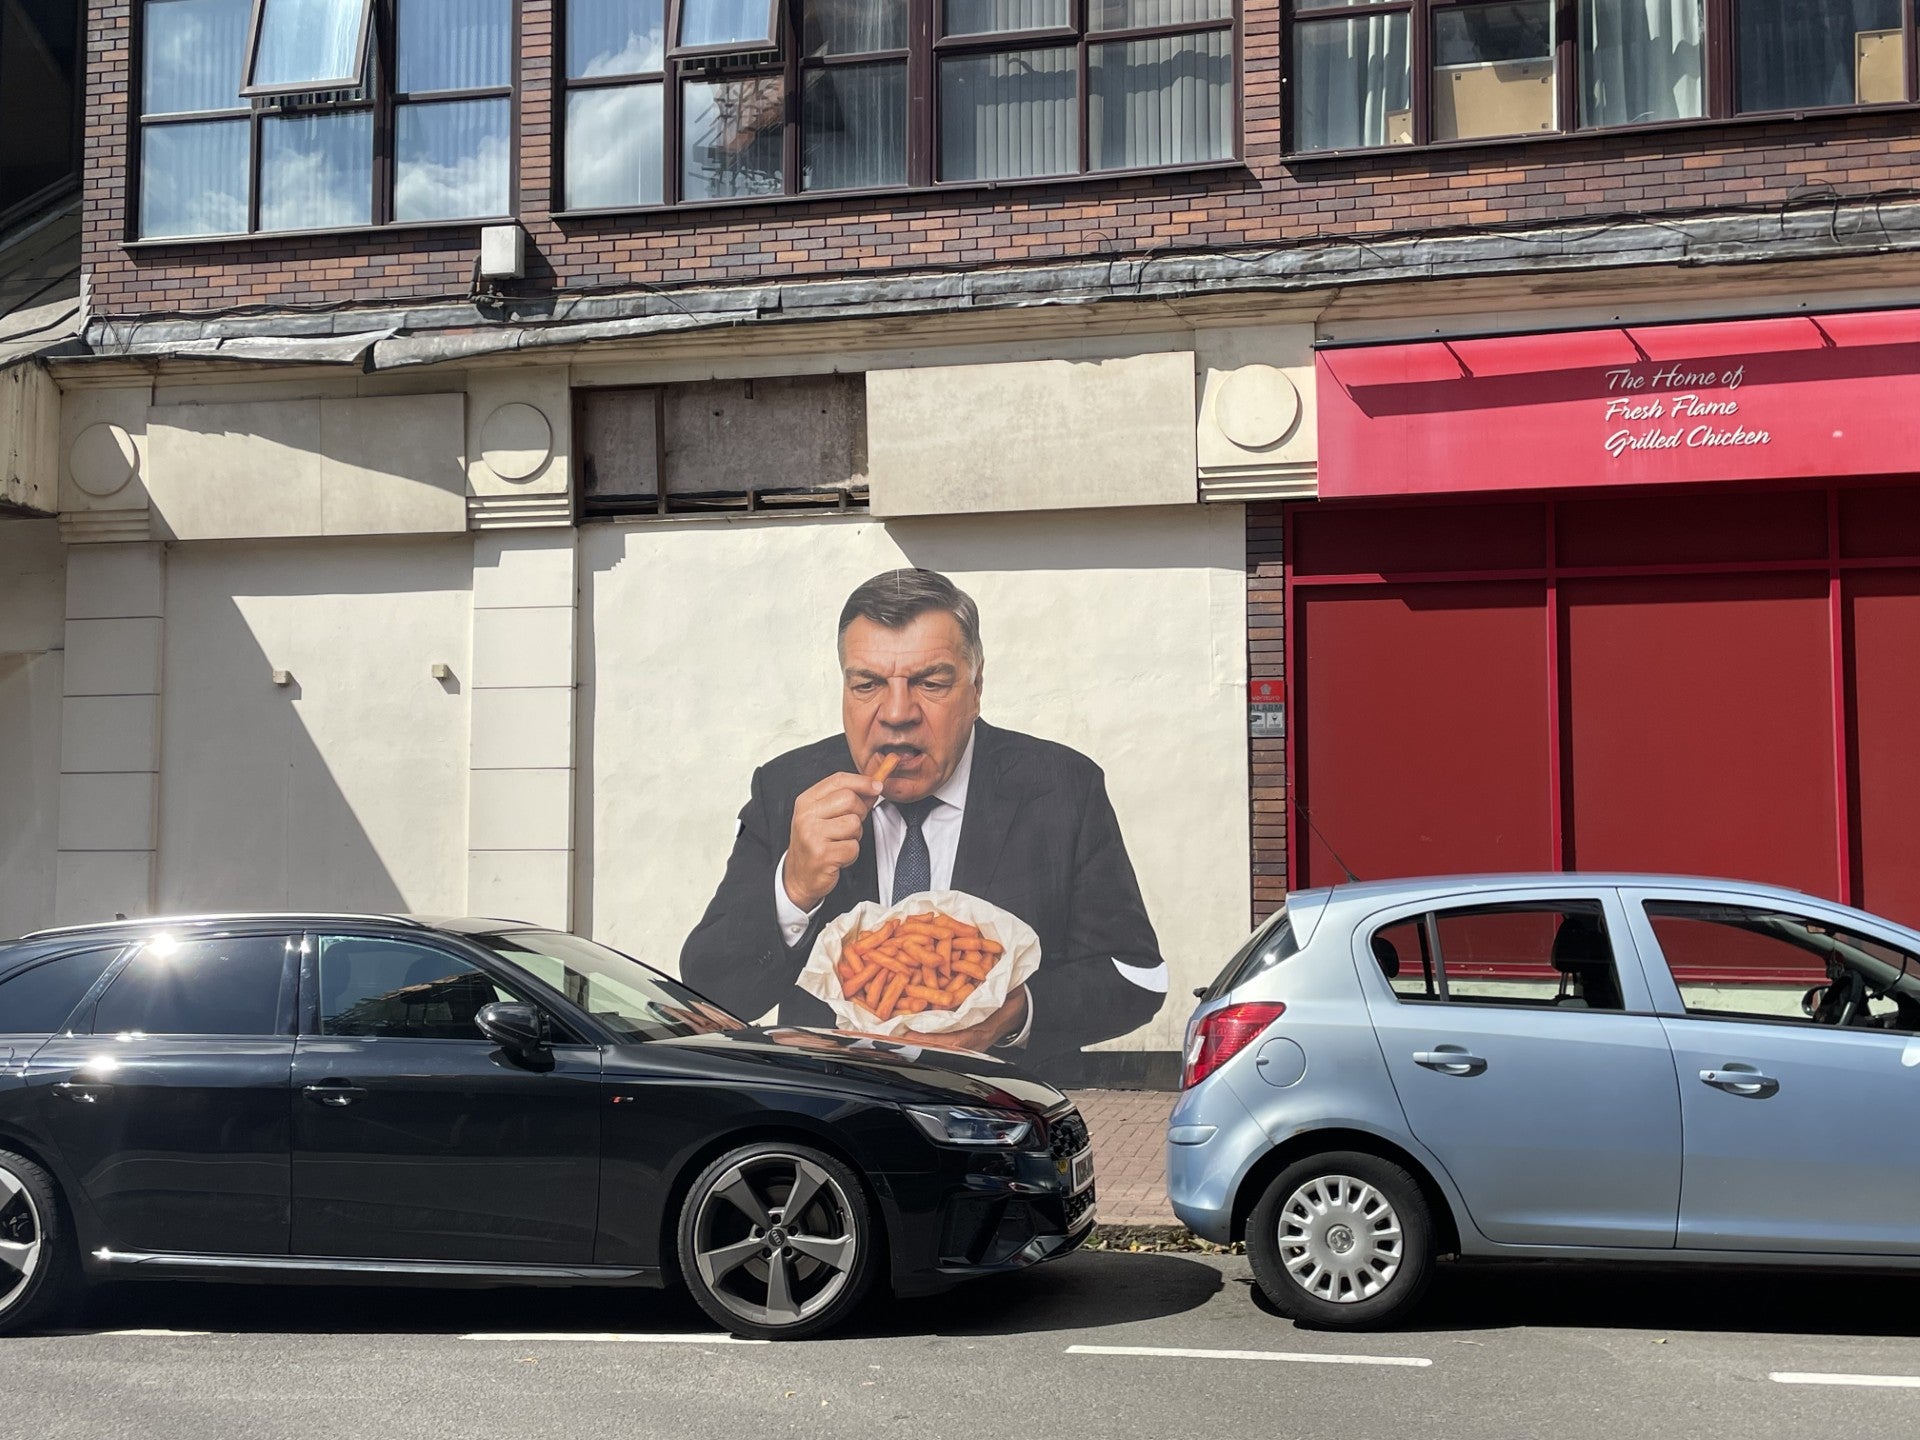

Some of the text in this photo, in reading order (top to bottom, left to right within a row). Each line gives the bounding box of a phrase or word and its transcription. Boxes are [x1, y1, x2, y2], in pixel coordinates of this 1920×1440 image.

[1605, 363, 1745, 390] The Home of
[1605, 394, 1738, 421] Fresh Flame
[1604, 425, 1771, 458] Grilled Chicken
[1251, 704, 1283, 712] ALARM
